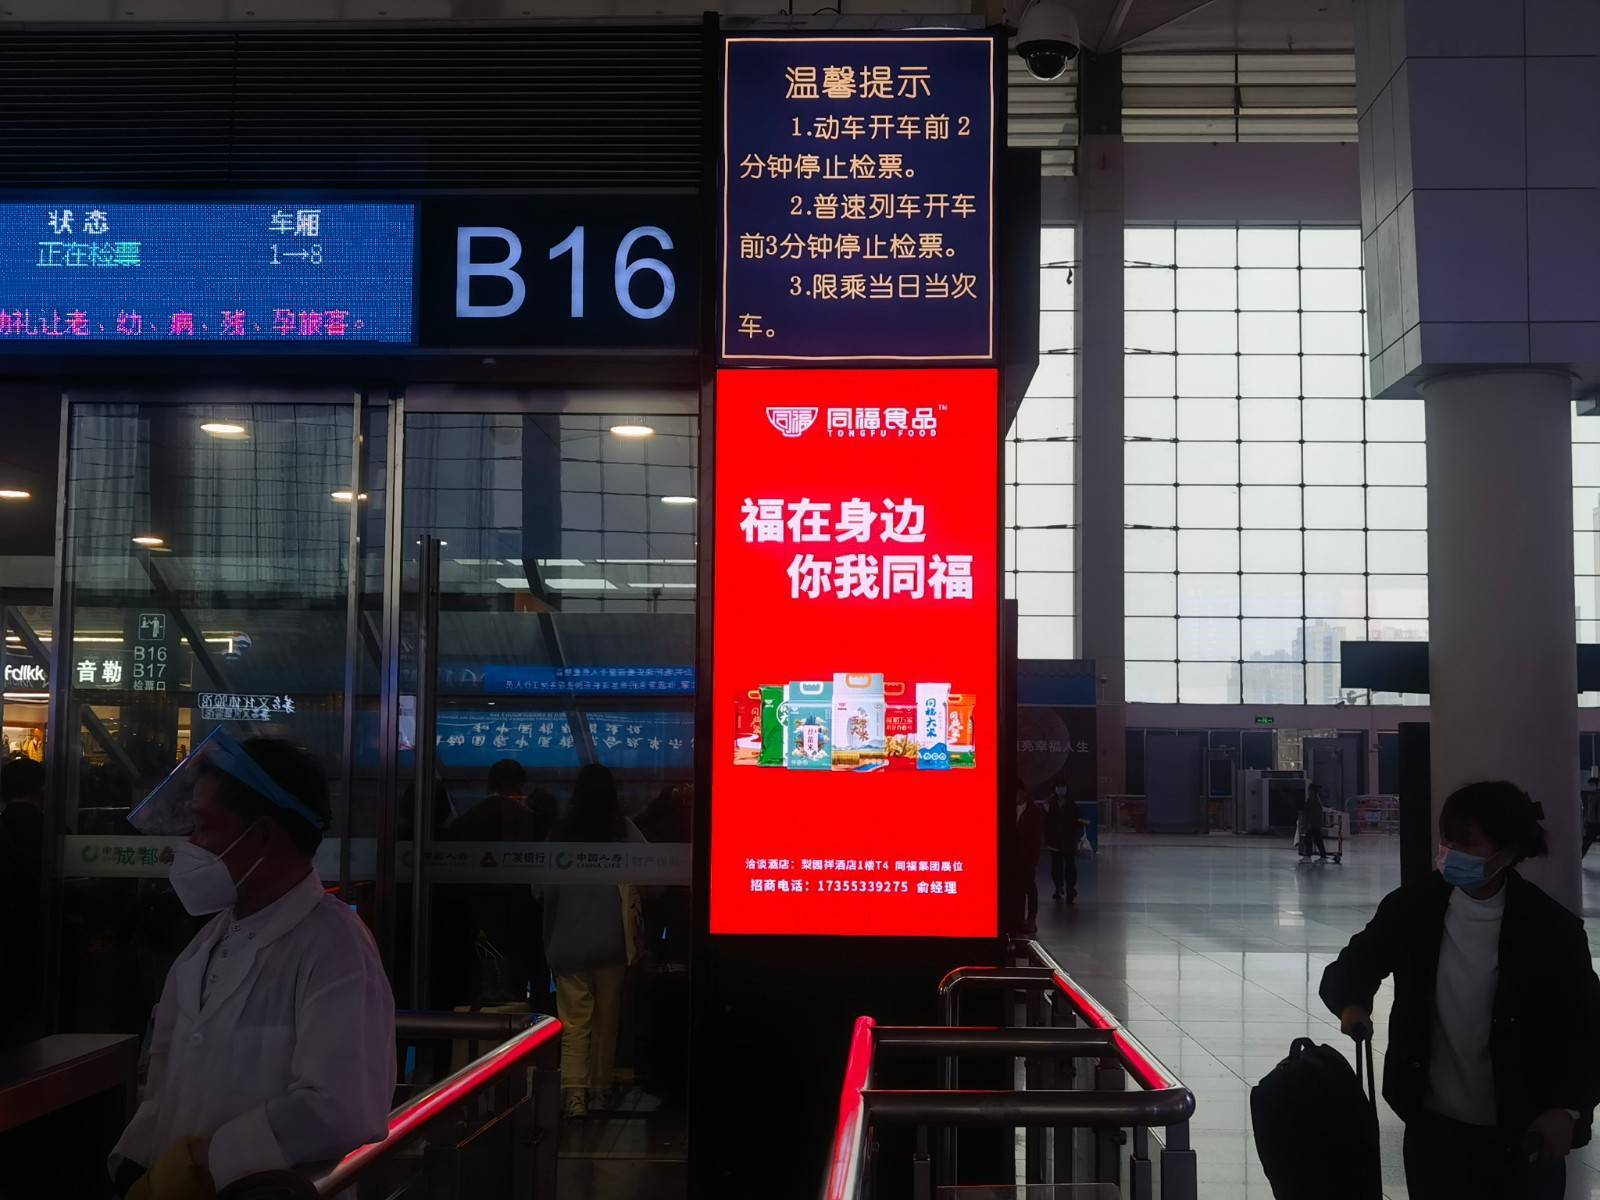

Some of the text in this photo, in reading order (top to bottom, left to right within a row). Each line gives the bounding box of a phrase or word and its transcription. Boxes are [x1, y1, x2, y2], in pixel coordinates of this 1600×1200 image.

[785, 65, 933, 100] 温馨提示
[739, 153, 917, 180] 分钟停止检票。
[790, 192, 977, 219] 2.普速列车开车
[48, 210, 110, 235] 状态
[268, 209, 322, 237] 车厢
[36, 242, 142, 268] 正在检票
[739, 232, 957, 260] 前3分钟停止检票。
[455, 225, 677, 320] B16
[790, 272, 978, 300] 3.限乘当日当次
[737, 313, 776, 340] 车。
[827, 407, 937, 430] 同福食品
[827, 429, 938, 437] TONGFU FOOD
[740, 497, 927, 543] 福在身边
[786, 554, 974, 600] 你我同福
[134, 646, 167, 661] B16
[76, 659, 123, 683] 音勒
[133, 663, 167, 678] B17
[916, 880, 958, 894] 俞经理
